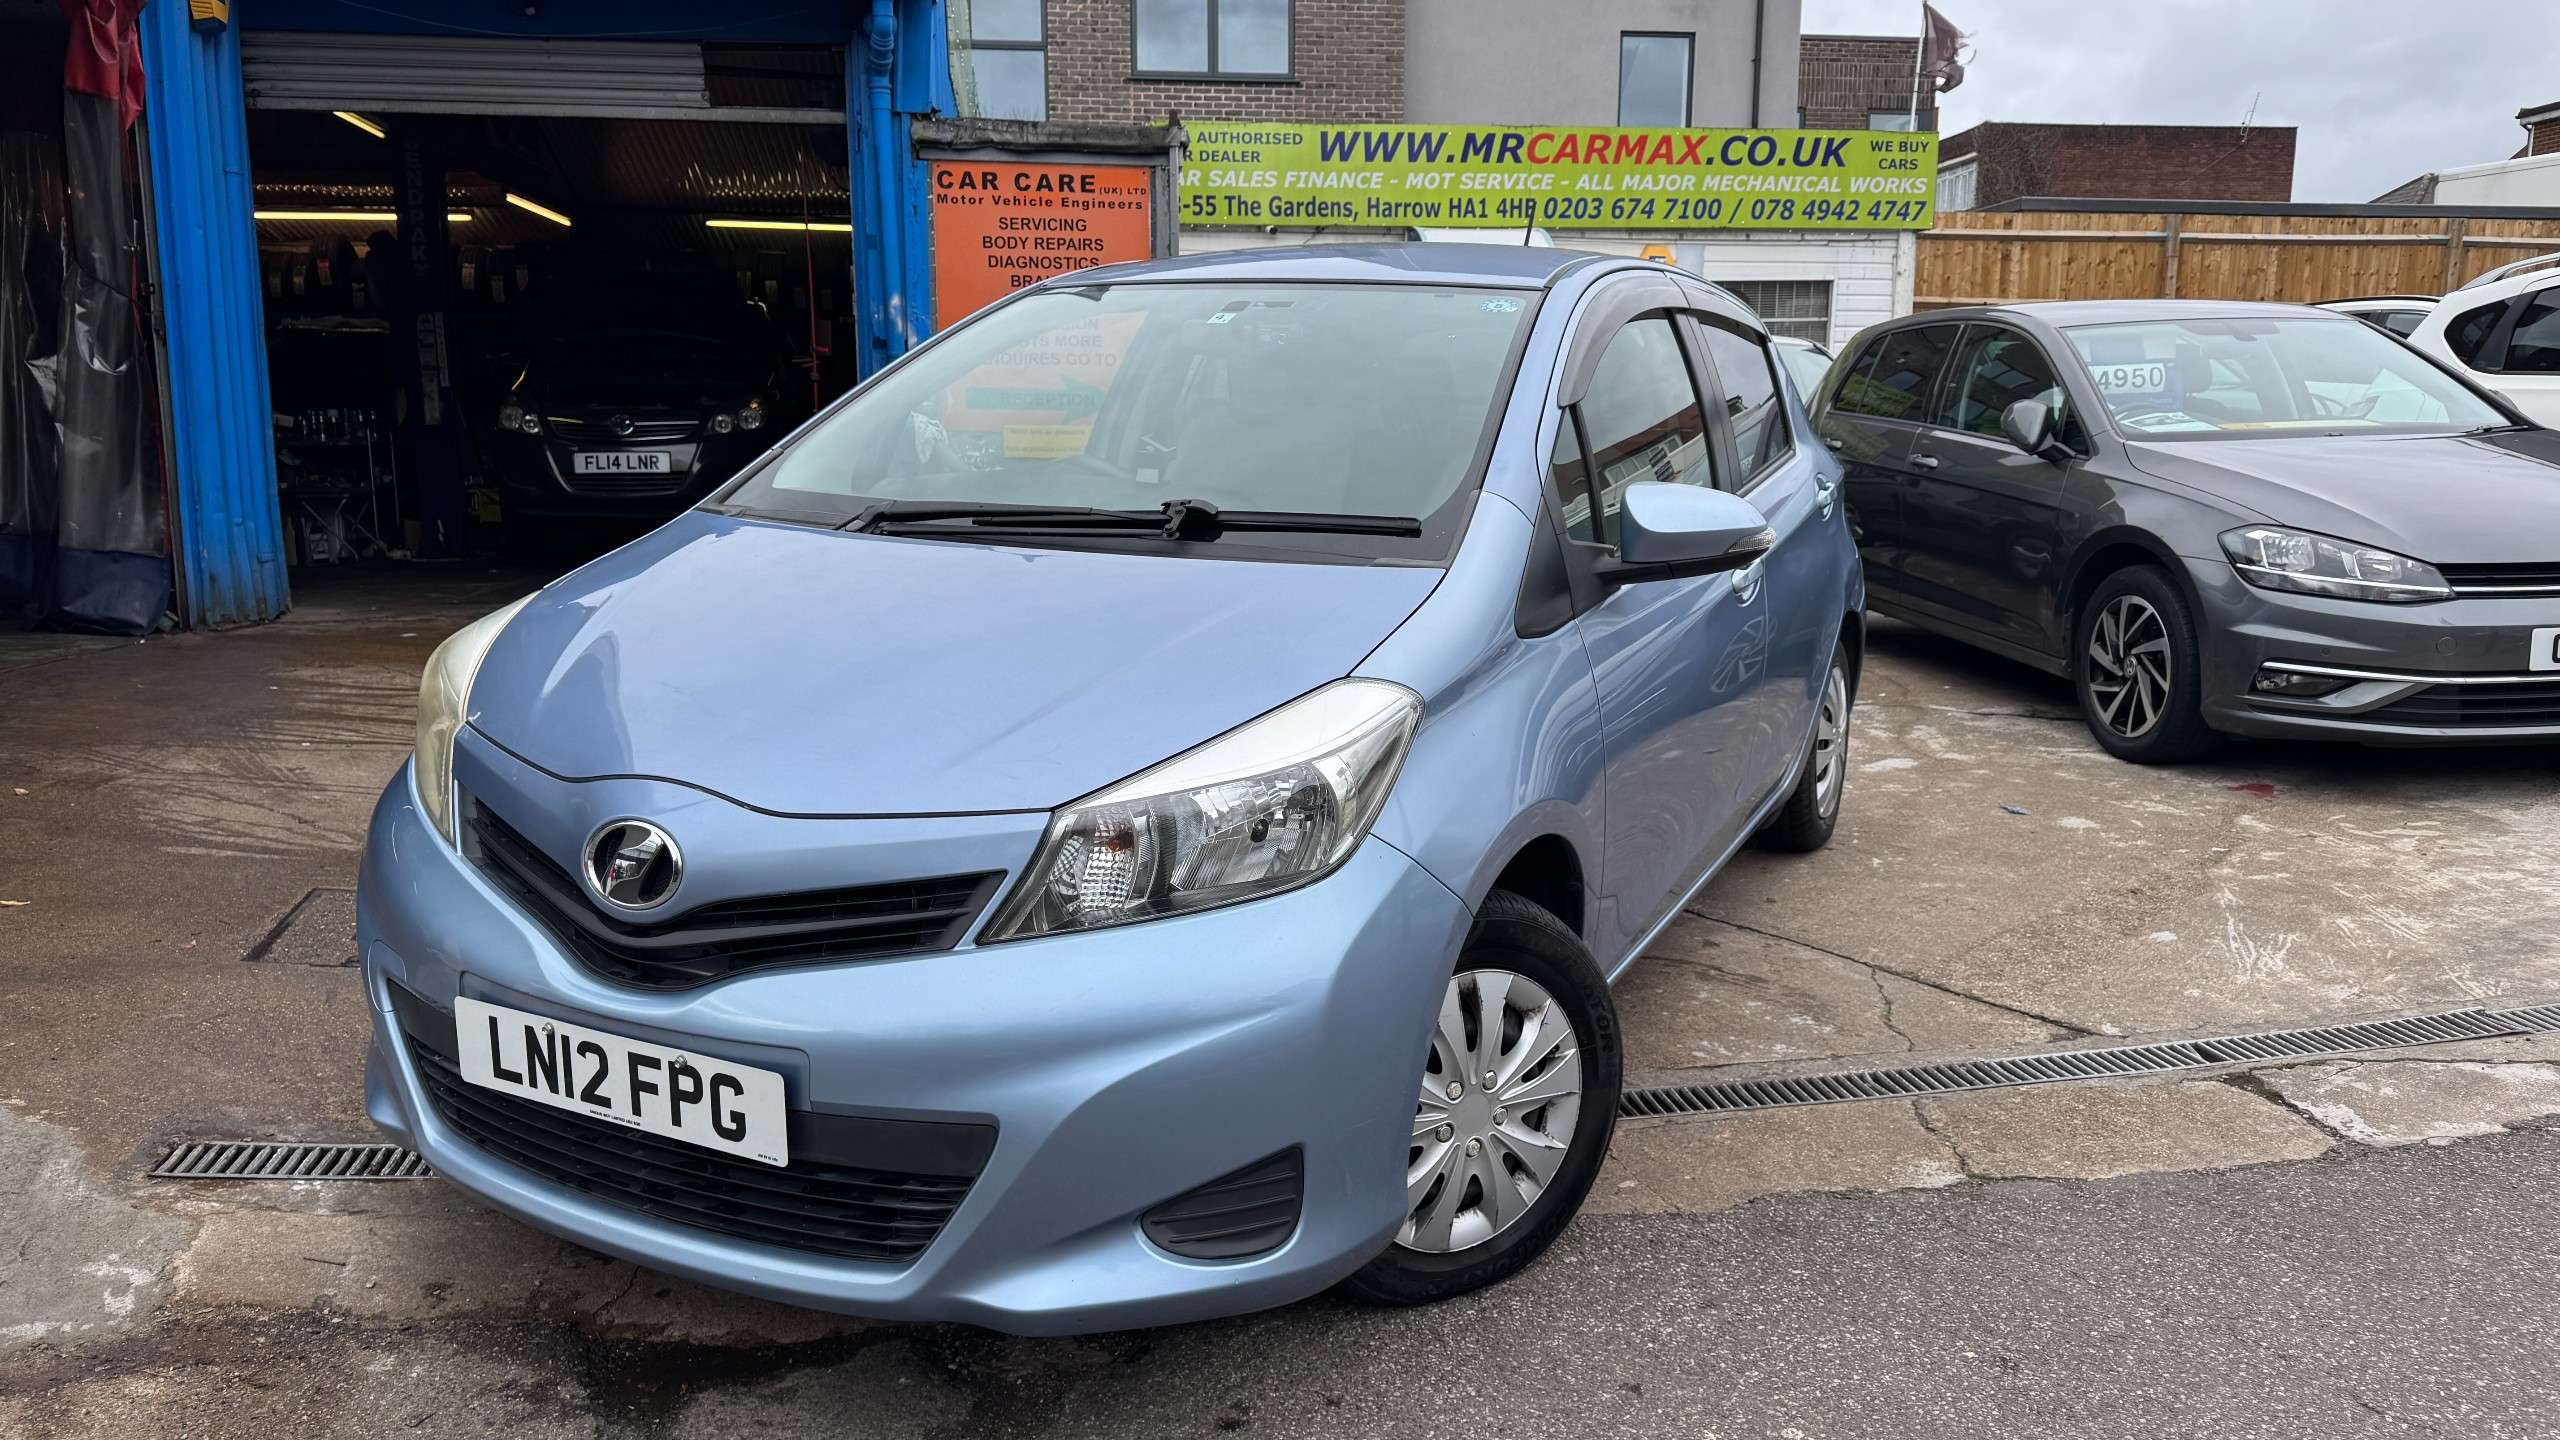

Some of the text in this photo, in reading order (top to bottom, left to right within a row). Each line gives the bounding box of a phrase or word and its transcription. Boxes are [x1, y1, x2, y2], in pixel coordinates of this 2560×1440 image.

[1197, 131, 1303, 145] AUTHORISED
[1320, 130, 1852, 168] WWW.MRCARMAX.CO.UK
[1870, 140, 1929, 153] WE BUY
[1200, 151, 1261, 162] DEALER
[1878, 158, 1918, 170] CARS
[937, 170, 999, 190] CAR
[1014, 173, 1095, 193] CARE
[1208, 170, 1278, 187] SALES
[1284, 171, 1384, 189] FINANCE
[1405, 172, 1456, 189] MOT
[1459, 173, 1555, 190] SERVICE
[1576, 174, 1615, 190] ALL
[1622, 174, 1697, 191] MAJOR
[1702, 175, 1841, 193] MECHANICAL
[1850, 176, 1928, 194] WORKS
[937, 195, 1143, 210] Motor Vehicle Engineers
[1179, 195, 1216, 216] -55
[1224, 194, 1261, 216] The
[1269, 195, 1358, 222] Gardens,
[1367, 197, 1441, 218] Harrow
[1449, 198, 1488, 218] HA1
[1544, 197, 1601, 219] 0203
[1611, 198, 1654, 219] 674
[1663, 198, 1722, 219] 7100
[1728, 199, 1743, 223] /
[1751, 199, 1793, 220] 078
[1802, 200, 1860, 221] 4942
[1867, 201, 1926, 222] 4747
[999, 217, 1087, 231] SERVICING
[983, 236, 1104, 251] BODY REPAIRS
[988, 255, 1100, 269] DIAGNOSTICS
[1011, 275, 1050, 287] BRA
[1055, 336, 1104, 348] MORE
[1066, 352, 1091, 366] GO
[1095, 353, 1117, 367] TO
[584, 456, 660, 470] FL14 LNR
[489, 1016, 746, 1143] LN12 FPG
